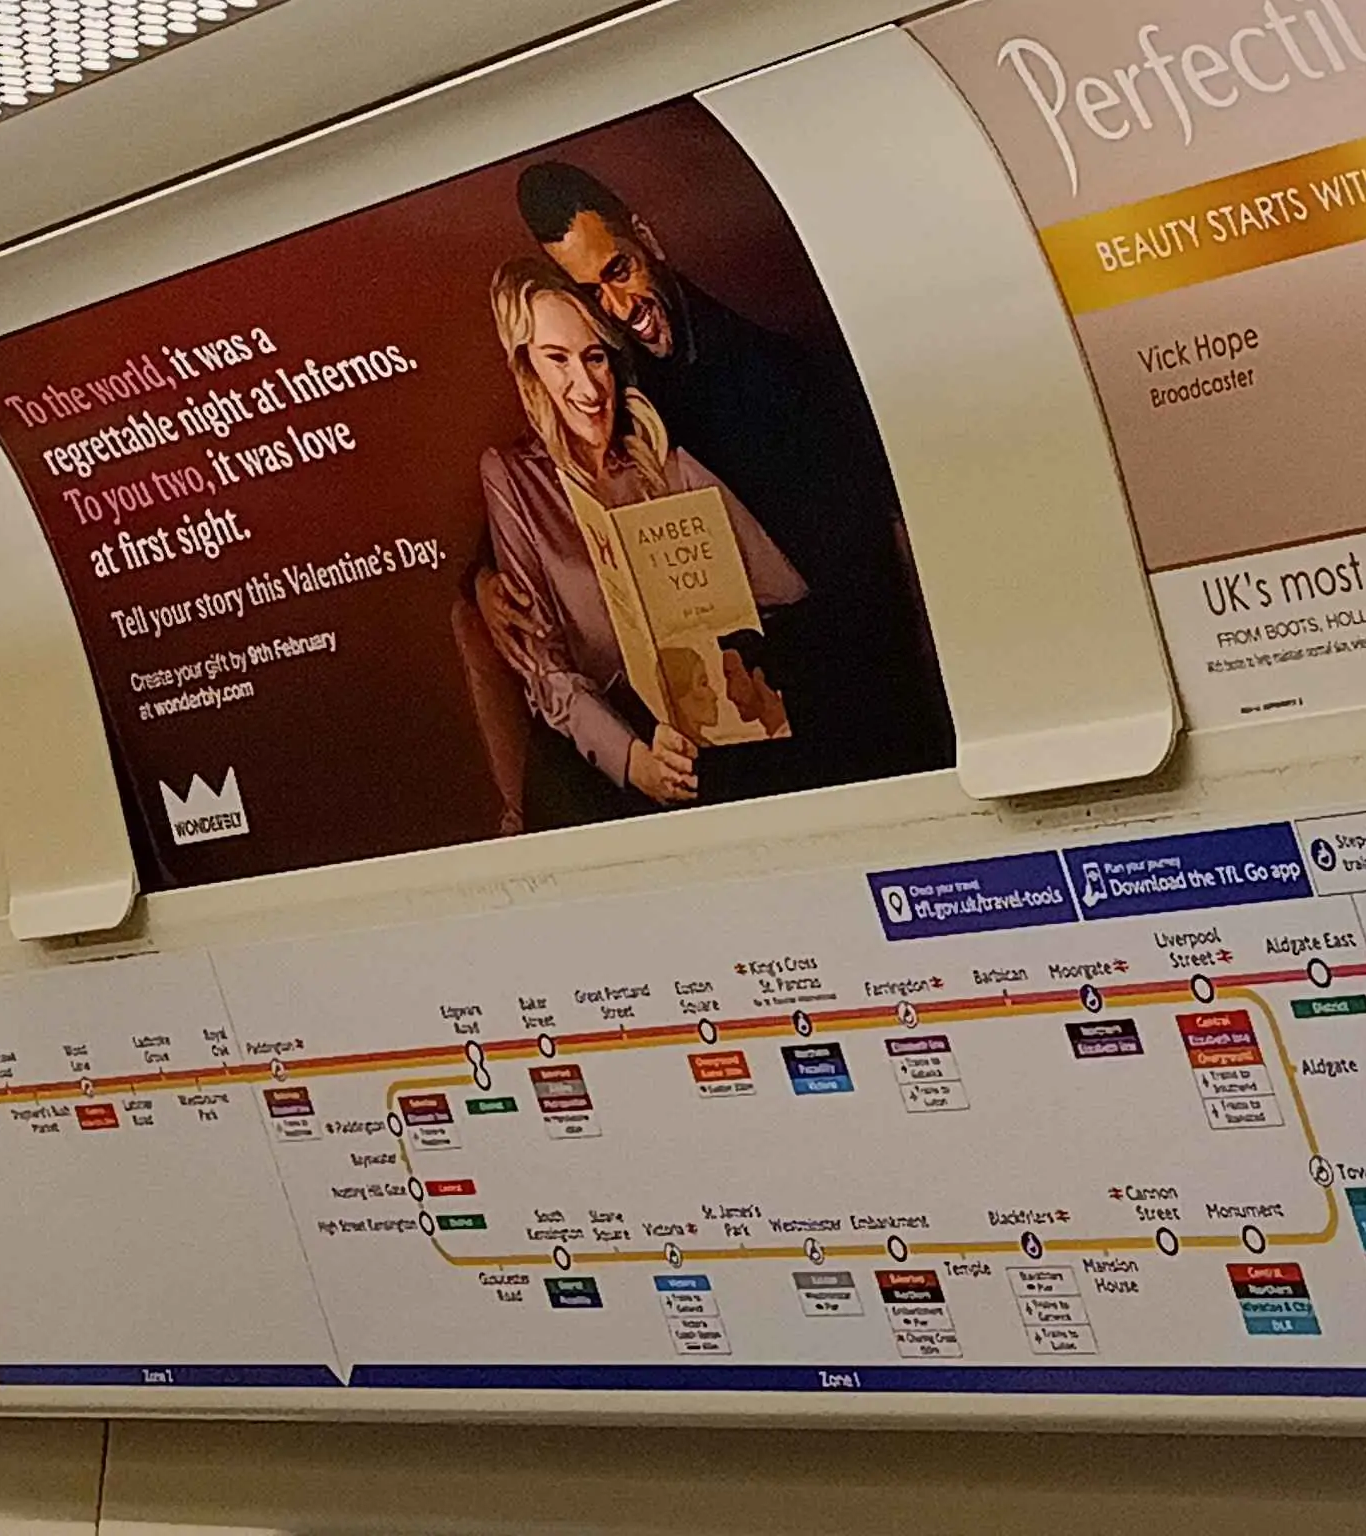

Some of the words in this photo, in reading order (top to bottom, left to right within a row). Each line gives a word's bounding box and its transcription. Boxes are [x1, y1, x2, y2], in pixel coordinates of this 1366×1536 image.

[1096, 214, 1201, 274] BEAUTY
[1207, 186, 1309, 245] STARTS
[1138, 334, 1190, 375] Vick
[1196, 322, 1260, 364] Hope
[5, 394, 49, 430] To
[49, 377, 92, 421] the
[90, 357, 178, 411] world,
[162, 346, 194, 382] it
[193, 333, 253, 375] was
[251, 326, 278, 356] a
[1150, 366, 1256, 409] Broadcaster
[42, 411, 180, 480] regrettable
[177, 384, 254, 439] night
[250, 379, 286, 416] at
[276, 343, 419, 406] Infernos.
[63, 488, 103, 527] To
[102, 477, 156, 526] you
[153, 461, 217, 508] two,
[208, 449, 240, 488] it
[237, 436, 295, 482] was
[287, 419, 357, 465] love
[89, 543, 121, 579] at
[117, 527, 178, 570] first
[177, 506, 252, 560] sight.
[637, 516, 707, 545] AMBER
[662, 542, 714, 567] LOVE
[111, 606, 151, 640] Tell
[150, 598, 194, 638] your
[194, 586, 245, 620] story
[246, 577, 287, 608] this
[395, 535, 447, 572] Day.
[668, 570, 709, 591] YOU
[1202, 571, 1273, 617] UK's
[1281, 552, 1363, 606] most
[1217, 625, 1264, 649] FROM
[1265, 615, 1323, 641] BOOTS,
[131, 666, 174, 692] Create
[173, 660, 203, 688] your
[204, 653, 230, 680] gift
[228, 651, 247, 673] by
[273, 630, 336, 661] February
[139, 703, 155, 721] at
[154, 679, 255, 717] wonderbly.com
[174, 811, 243, 840] WONDERBLY
[1108, 871, 1186, 898] Download
[1189, 868, 1216, 887] the
[1245, 864, 1267, 882] Go
[1268, 861, 1302, 885] app
[914, 885, 1064, 922] tfl.gov.uk/travel-tools
[1154, 927, 1222, 949] Liverpool
[1266, 935, 1322, 955] Aldgate
[1323, 932, 1357, 949] East
[784, 956, 819, 972] Cross
[1048, 959, 1112, 980] Moorgate
[1169, 950, 1217, 969] Street
[973, 967, 1030, 983] Barbican
[864, 979, 931, 999] Farringdon
[1302, 1057, 1359, 1077] Aldgate
[1124, 1184, 1179, 1203] Cannon
[986, 1209, 1055, 1228] Blackfriars
[1133, 1205, 1182, 1223] Street
[1205, 1202, 1284, 1221] Monument
[943, 1259, 993, 1279] Temple
[1082, 1256, 1140, 1275] Mansion
[1094, 1277, 1141, 1295] House
[818, 1370, 852, 1389] Zone
